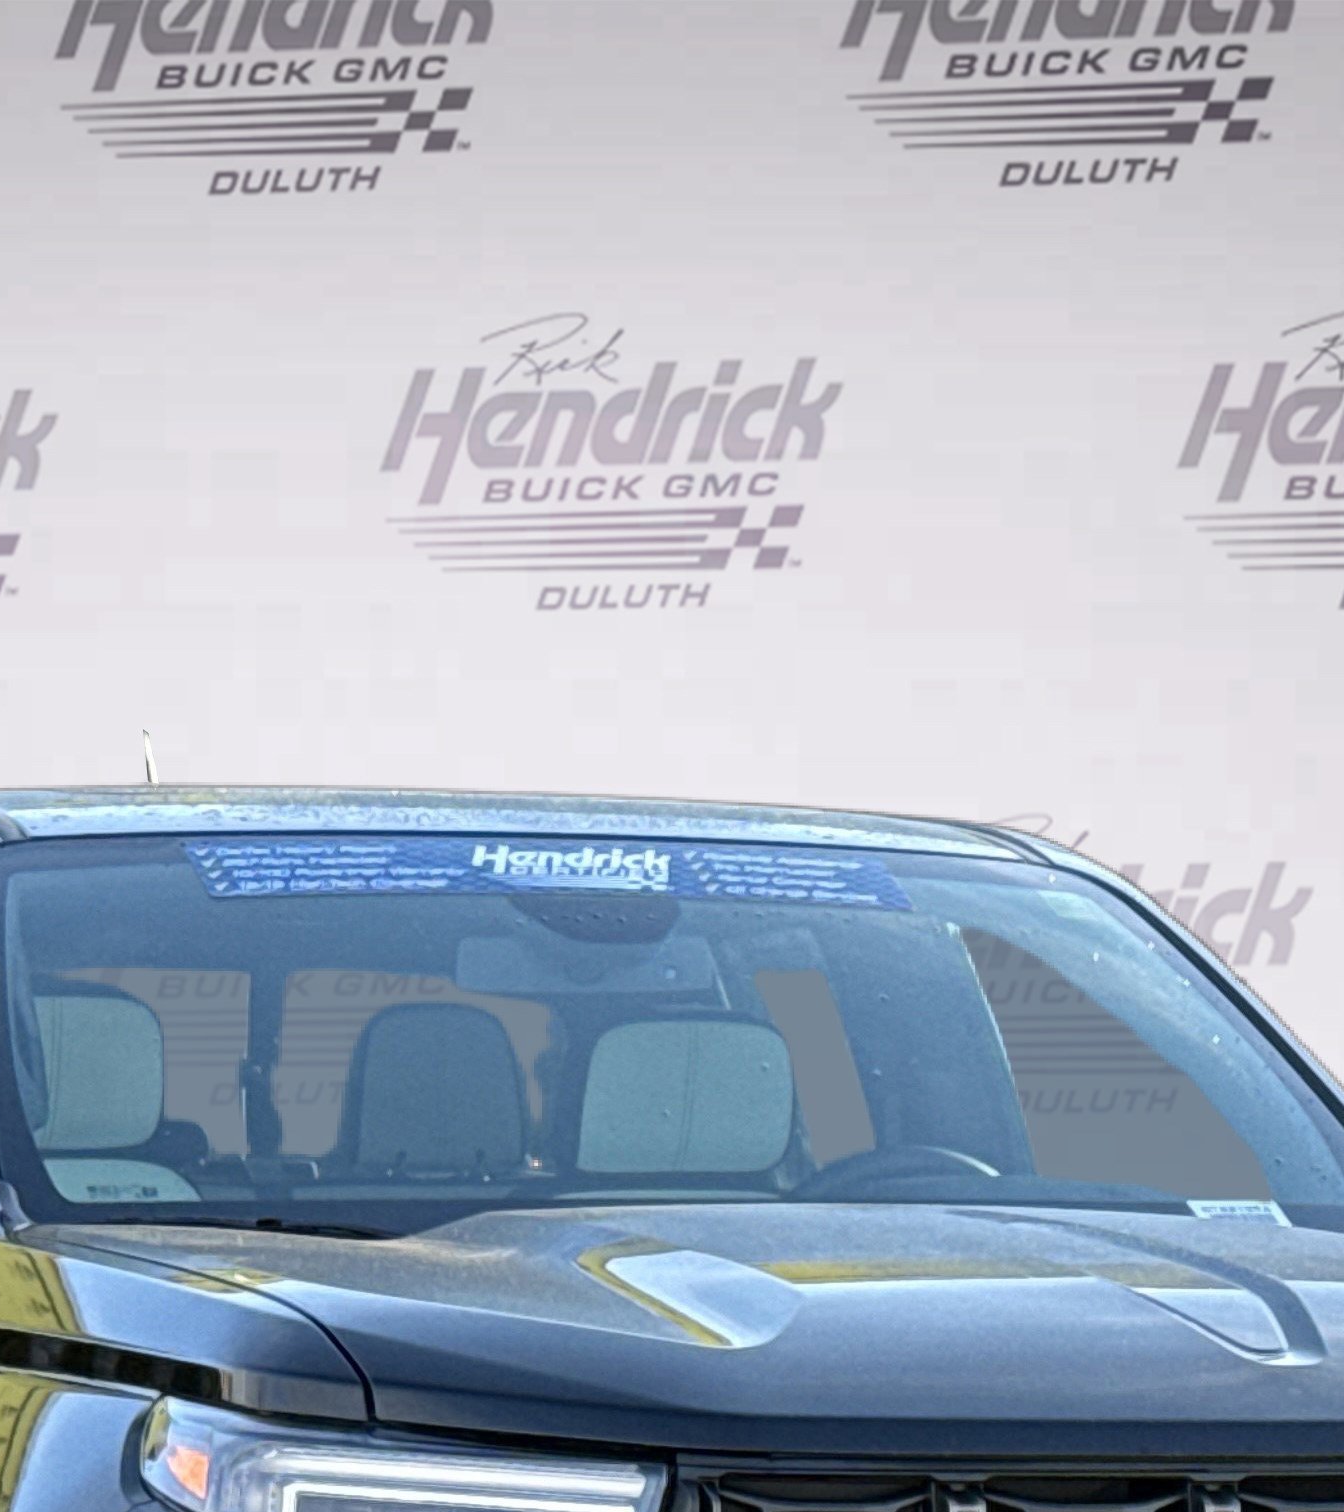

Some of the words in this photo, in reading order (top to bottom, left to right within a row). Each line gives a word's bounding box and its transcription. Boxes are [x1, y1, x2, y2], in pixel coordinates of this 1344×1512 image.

[156, 60, 315, 89] BUICK
[333, 55, 448, 83] GMC
[945, 49, 1110, 79] BUICK
[1129, 44, 1248, 72] GMC
[209, 166, 381, 195] DULUTH
[1000, 157, 1178, 187] DULUTH
[380, 357, 844, 505] Hendrick
[483, 475, 643, 503] BUICK
[663, 472, 779, 498] GMC
[536, 583, 711, 610] DULUTH
[472, 845, 671, 874] Hendrick
[158, 974, 311, 998] BUIK
